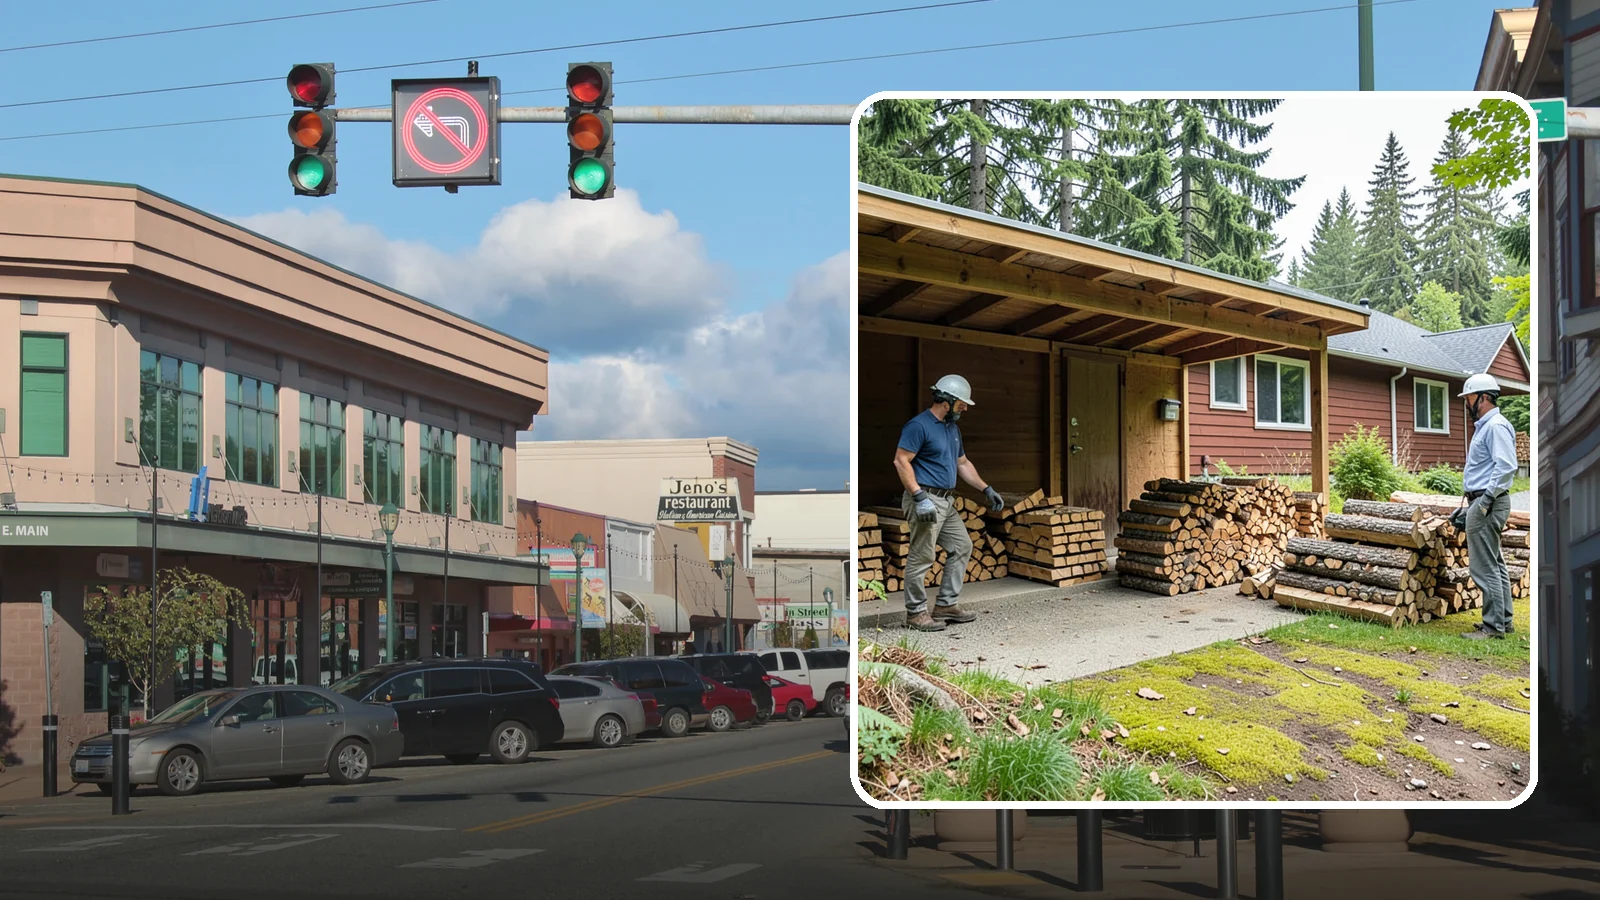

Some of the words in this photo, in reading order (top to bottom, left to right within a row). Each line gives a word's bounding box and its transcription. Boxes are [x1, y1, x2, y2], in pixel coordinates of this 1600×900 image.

[670, 480, 727, 494] Jeno's
[665, 496, 731, 509] restaurant
[658, 509, 681, 519] Italian
[685, 509, 714, 519] American
[715, 509, 738, 519] Cuisine
[2, 525, 13, 536] E.
[15, 525, 49, 536] MAIN
[797, 607, 828, 617] Street
